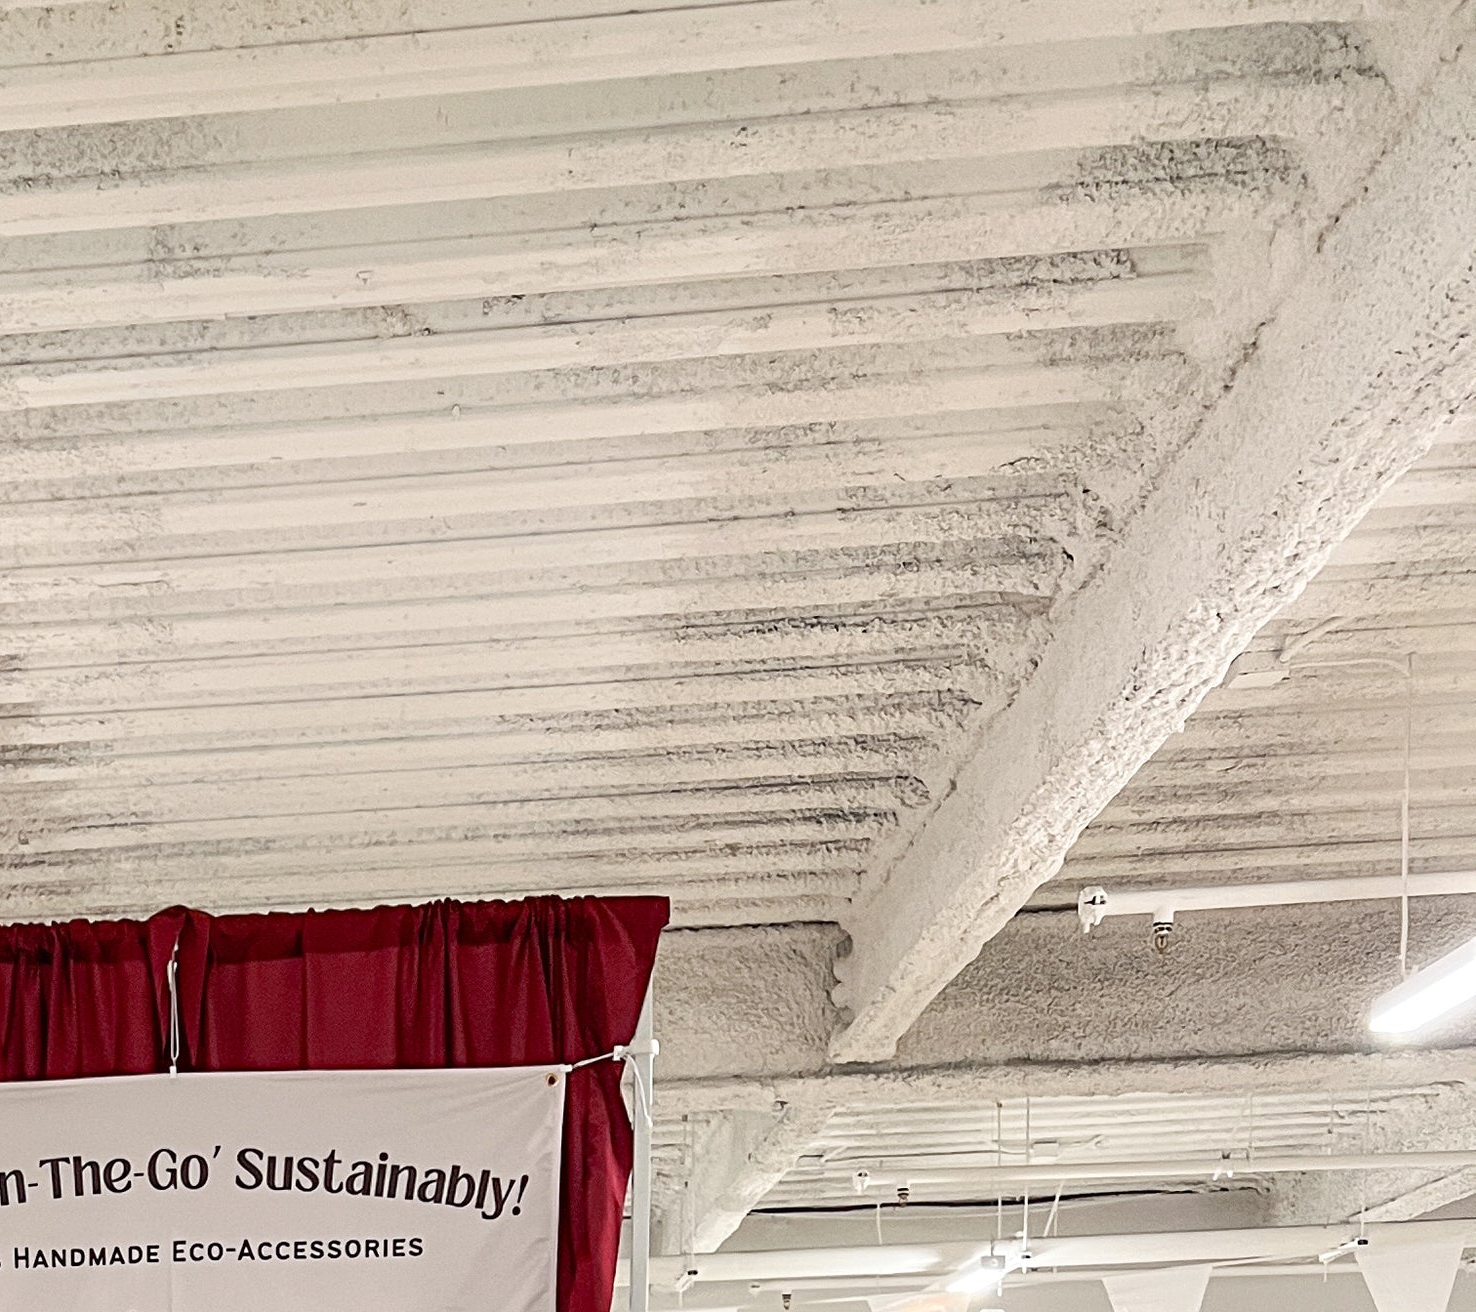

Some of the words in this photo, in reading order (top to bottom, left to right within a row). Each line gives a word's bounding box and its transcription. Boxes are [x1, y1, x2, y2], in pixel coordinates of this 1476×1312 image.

[234, 1147, 531, 1221] Sustainably!
[12, 1240, 161, 1269] HANDMADE
[171, 1236, 425, 1264] ECO-ACCESSORIES
